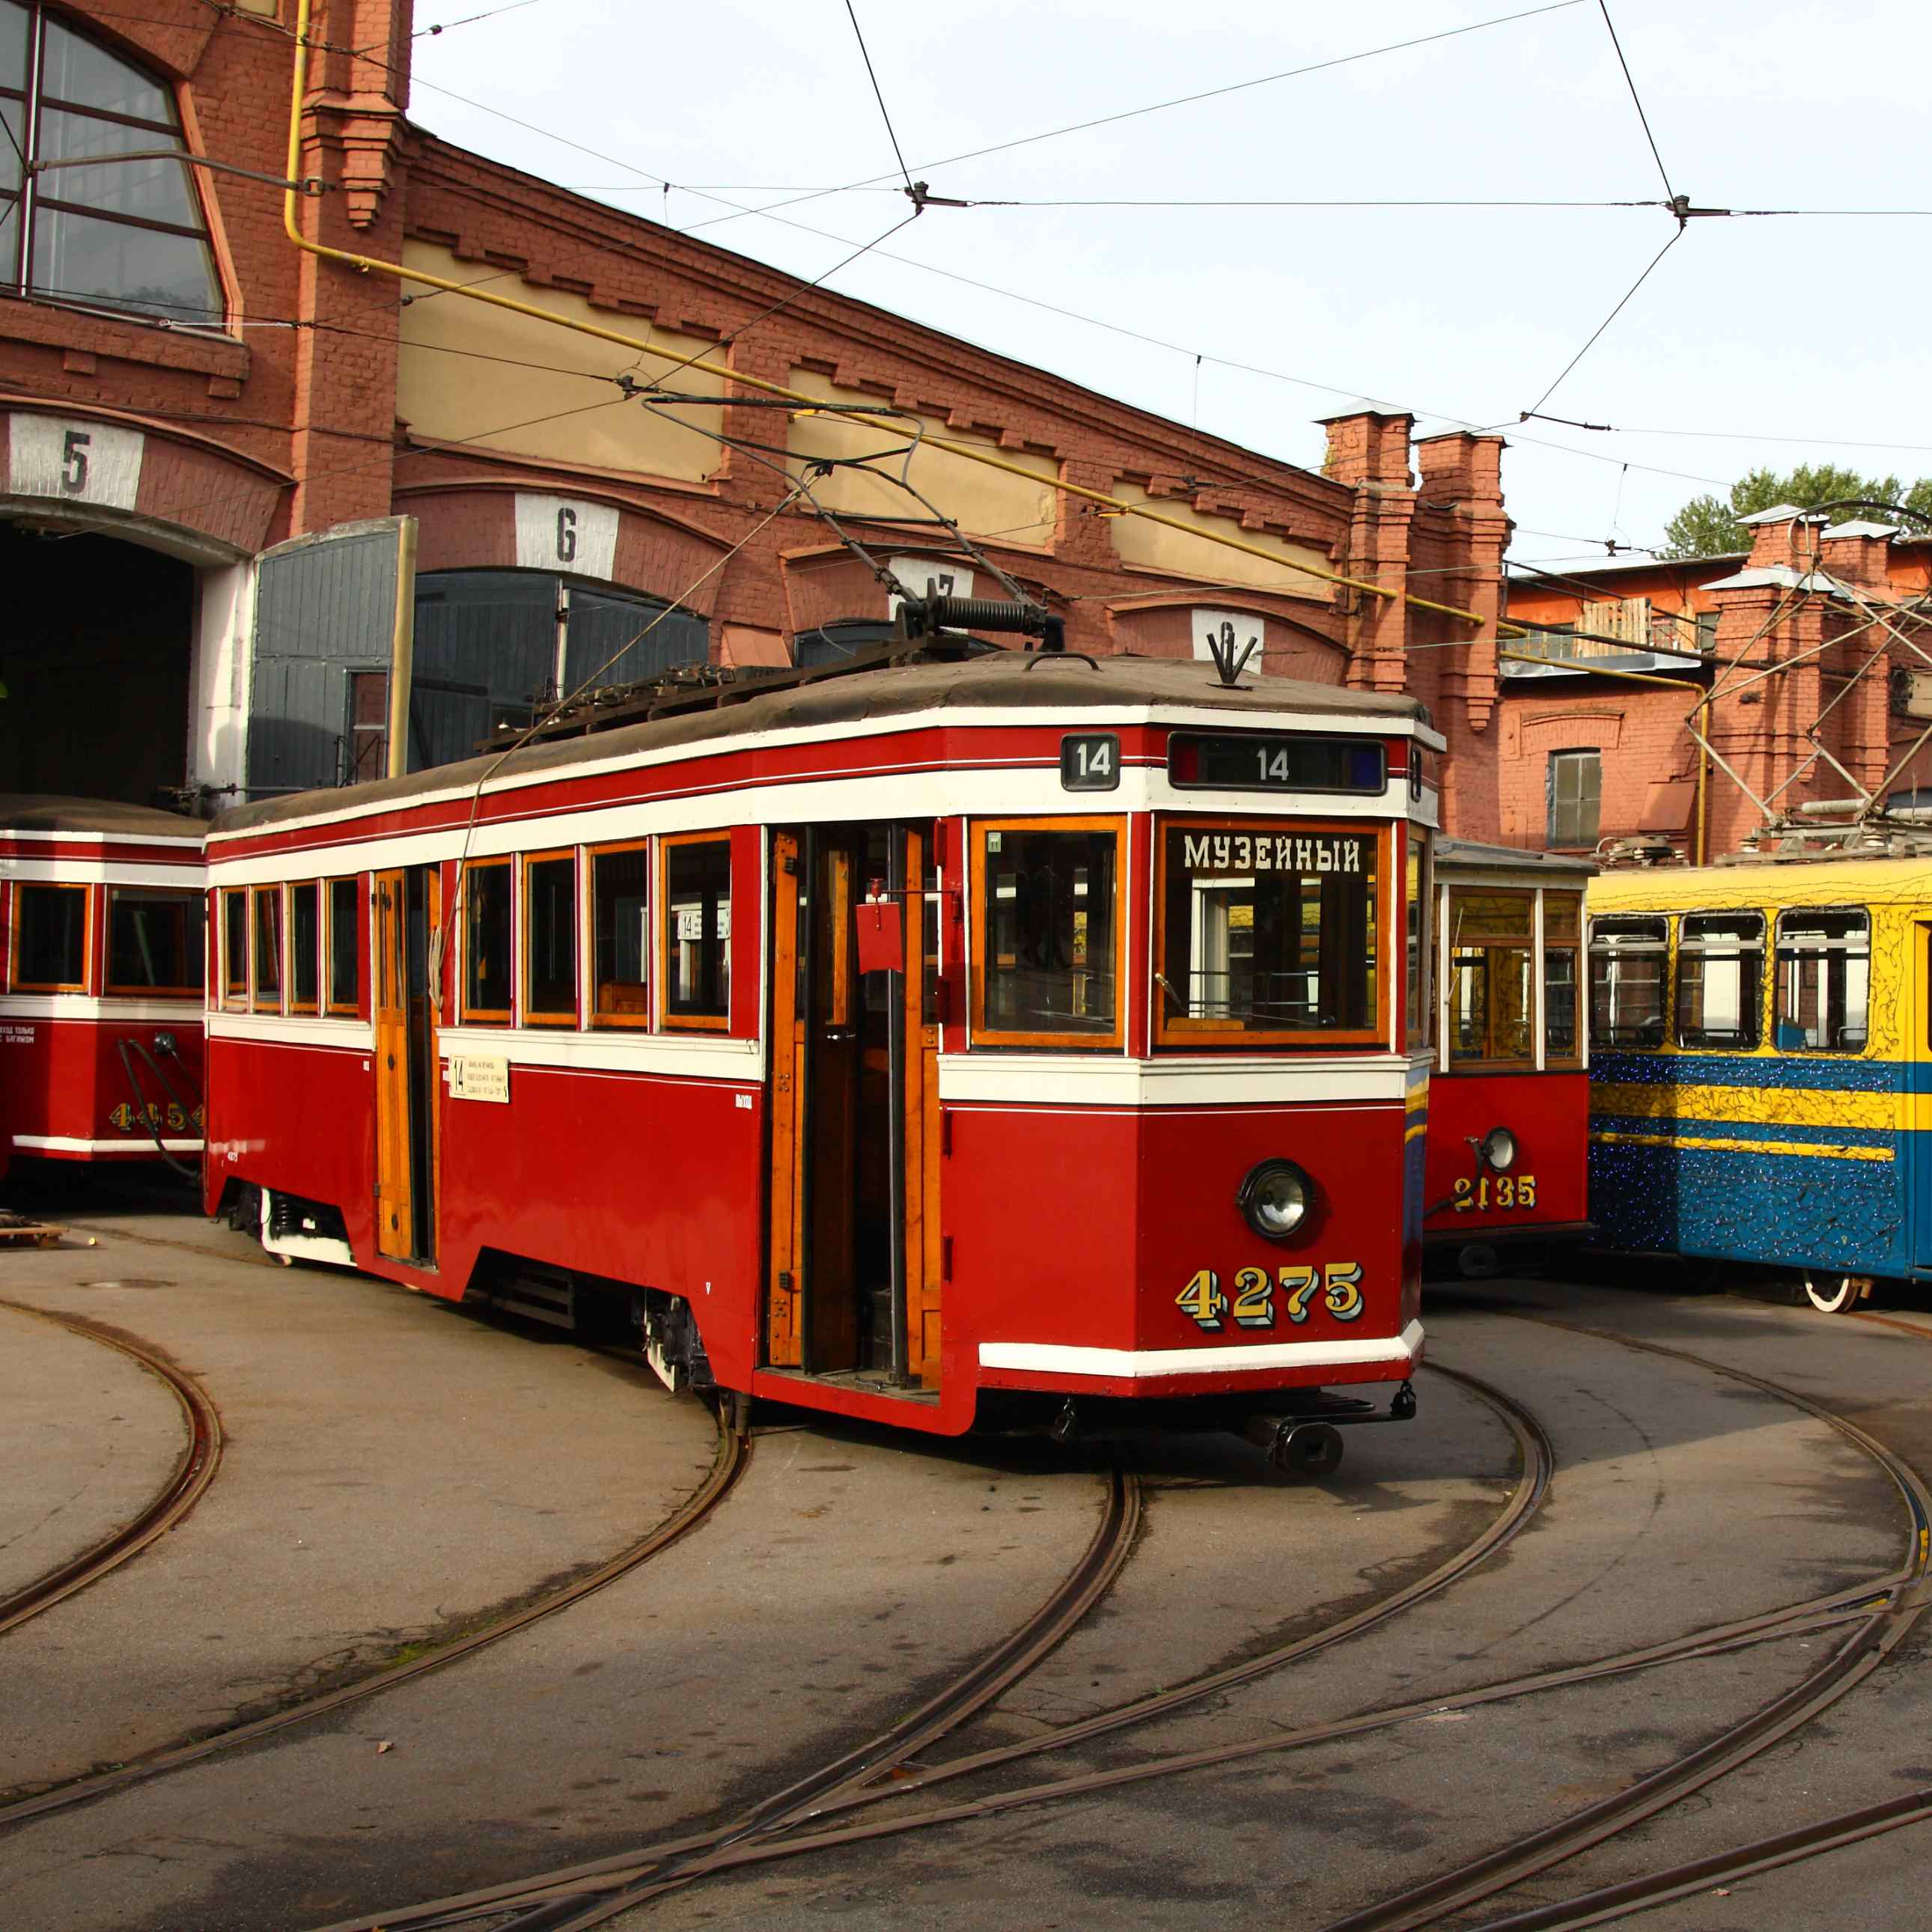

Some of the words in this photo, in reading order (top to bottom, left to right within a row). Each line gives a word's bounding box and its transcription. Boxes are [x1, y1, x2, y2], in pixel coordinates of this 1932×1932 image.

[62, 430, 90, 494] 5
[556, 508, 576, 563] 6
[1076, 742, 1111, 776] 14
[1256, 746, 1290, 781] 14
[1183, 835, 1360, 873] МУЗЕЙНЫЙ
[454, 1059, 464, 1092] 14
[1454, 1175, 1536, 1211] 2135
[1174, 1261, 1364, 1332] 4275
